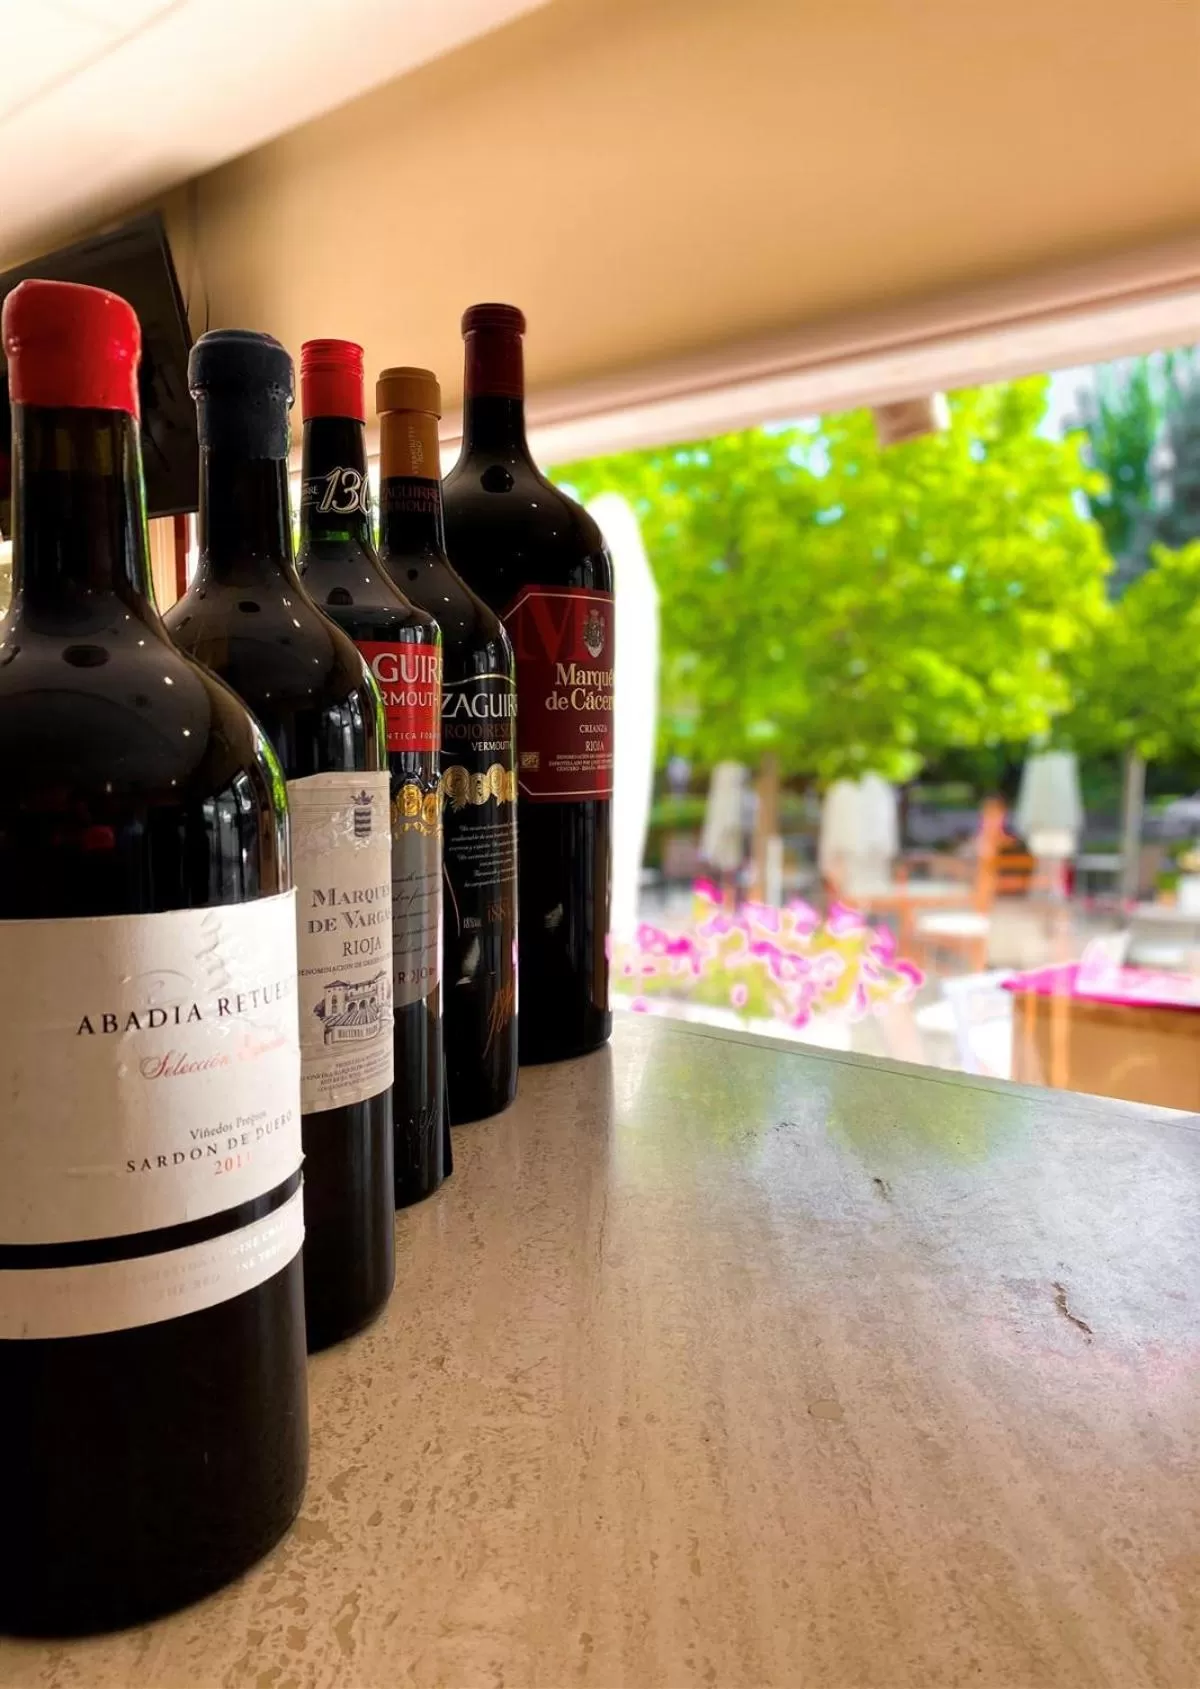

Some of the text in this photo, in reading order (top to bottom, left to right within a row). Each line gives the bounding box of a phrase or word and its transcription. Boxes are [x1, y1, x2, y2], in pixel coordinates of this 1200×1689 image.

[545, 690, 569, 711] de
[579, 724, 608, 733] CRIANZA
[585, 740, 605, 751] RIOJA
[307, 918, 337, 934] DE
[342, 936, 382, 957] RIOJA
[76, 980, 290, 1036] ABADIA RETUE
[190, 1121, 234, 1140] Viñedos
[126, 1109, 293, 1173] SARDON DE DUERO
